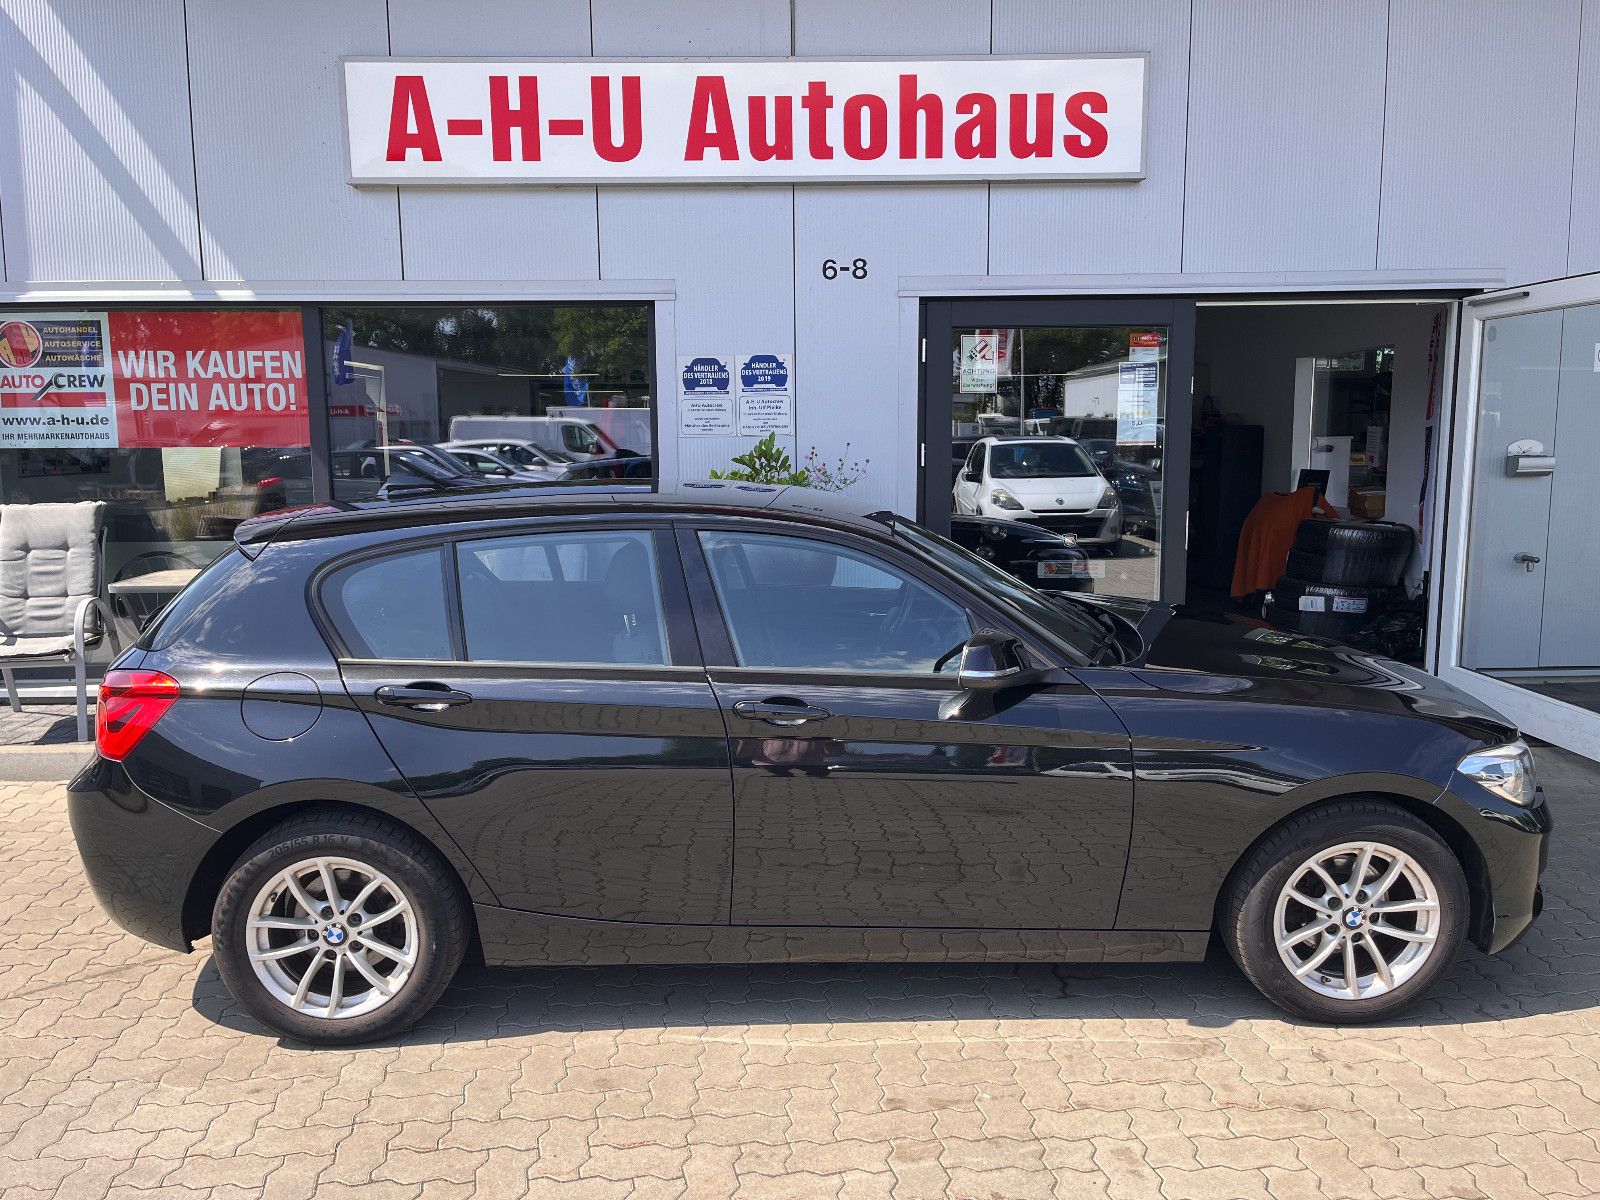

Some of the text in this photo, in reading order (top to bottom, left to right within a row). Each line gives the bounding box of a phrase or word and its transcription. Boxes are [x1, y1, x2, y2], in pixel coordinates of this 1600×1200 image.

[386, 74, 1109, 162] A-H-U Autohaus
[822, 258, 868, 280] 6-8
[42, 326, 98, 334] AUTOHANDEL
[44, 340, 102, 348] AUTOSERVICE
[118, 350, 177, 379] WIR
[187, 350, 303, 379] KAUFEN
[130, 383, 297, 411] DEIN AUTO!
[2, 414, 110, 426] www.a-h-u.de
[2, 432, 110, 441] IHR MEHRMARKENAUTOHAUS
